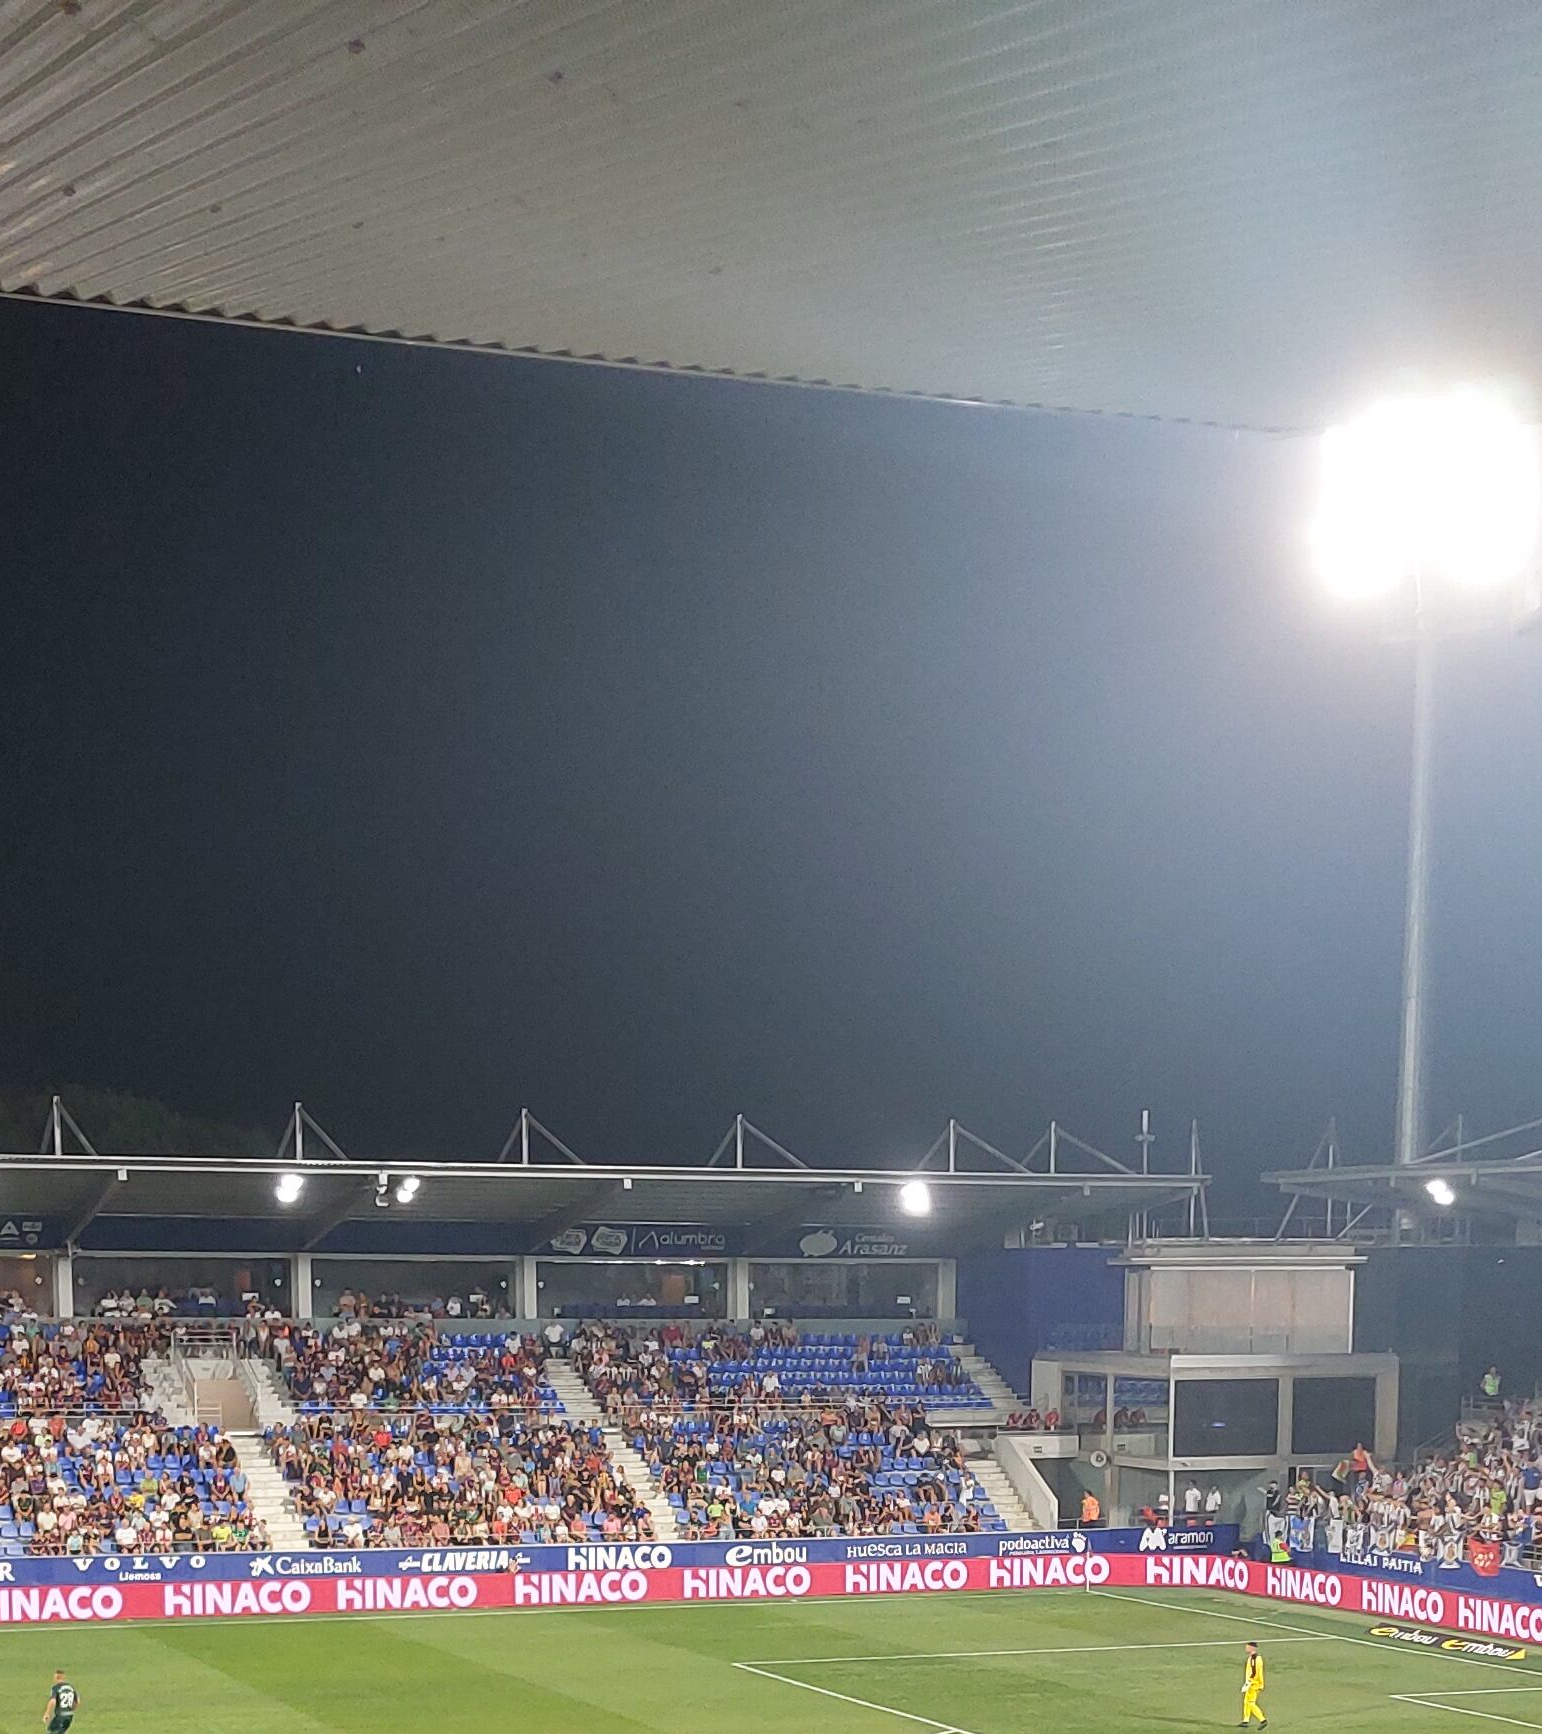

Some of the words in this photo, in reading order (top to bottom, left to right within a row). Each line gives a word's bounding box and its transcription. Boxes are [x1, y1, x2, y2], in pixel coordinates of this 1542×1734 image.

[839, 1240, 907, 1256] Arasanz
[999, 1533, 1070, 1557] podoactiva
[1167, 1530, 1214, 1545] aramon
[73, 1555, 207, 1571] VOLVO
[276, 1555, 362, 1575] CaixaBank
[420, 1551, 509, 1573] CLAVERIA
[567, 1546, 672, 1571] HINACO
[726, 1541, 807, 1567] embou
[683, 1566, 811, 1599] HINACO
[845, 1561, 968, 1593] HINACO
[989, 1555, 1110, 1588] HINACO
[1146, 1556, 1249, 1591] HINACO
[1266, 1566, 1343, 1607] HINACO
[164, 1580, 310, 1616] HINACO
[337, 1576, 477, 1611] HINACO
[515, 1571, 648, 1605] HINACO
[1362, 1580, 1445, 1623] HINACO
